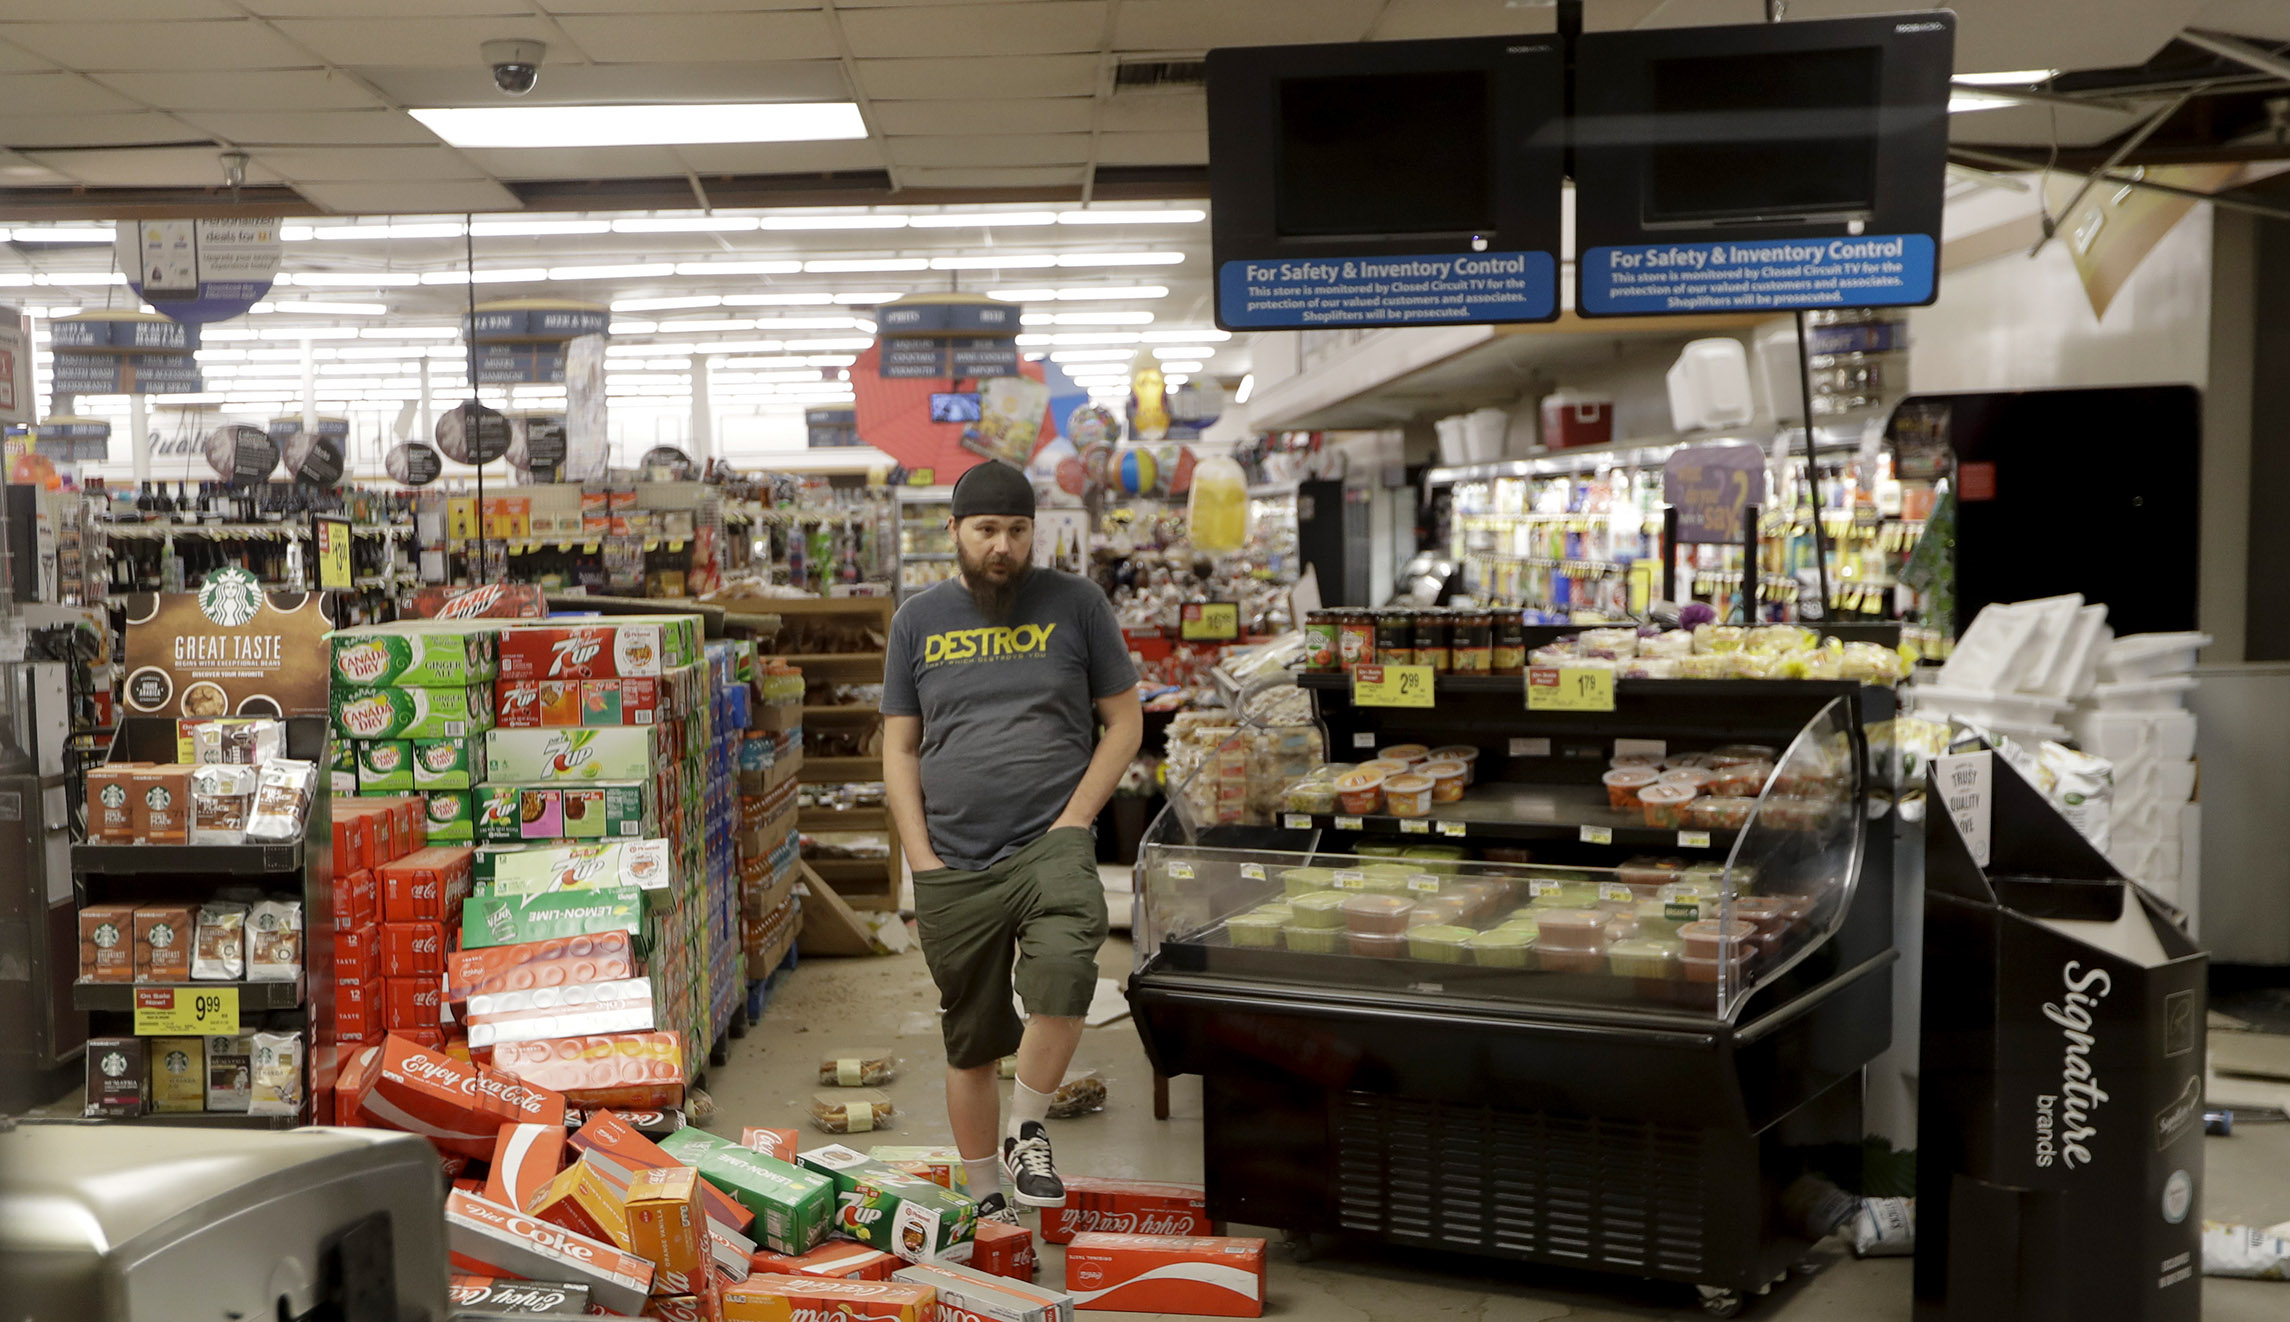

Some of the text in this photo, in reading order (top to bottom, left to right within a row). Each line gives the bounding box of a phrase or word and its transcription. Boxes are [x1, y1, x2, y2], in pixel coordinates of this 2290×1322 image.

[1610, 250, 1642, 268] For
[1645, 247, 1708, 270] Safety
[1730, 244, 1826, 265] Inventory
[1828, 237, 1903, 260] Control
[1246, 264, 1277, 281] For
[1280, 262, 1339, 284] Safety
[1361, 258, 1451, 280] Inventory
[1453, 254, 1525, 276] Control
[1611, 271, 1635, 283] This
[1637, 272, 1668, 283] store
[1680, 267, 1743, 281] monitored
[1761, 265, 1801, 278] Closed
[1803, 263, 1842, 276] Circuit
[1862, 261, 1880, 273] for
[1882, 260, 1903, 273] the
[1248, 286, 1272, 297] This
[1273, 286, 1301, 297] store
[1314, 282, 1373, 295] monitored
[1391, 280, 1429, 293] Closed
[1431, 278, 1468, 291] Circuit
[1487, 276, 1505, 289] for
[1506, 277, 1526, 288] the
[1610, 285, 1671, 299] protection
[1687, 285, 1708, 294] our
[1710, 281, 1750, 293] valued
[1751, 280, 1812, 292] customers
[1814, 277, 1838, 289] and
[1840, 275, 1904, 288] associates.
[1247, 299, 1306, 312] protection
[1321, 299, 1340, 308] our
[1343, 296, 1380, 307] valued
[1382, 294, 1440, 306] customers
[1442, 293, 1464, 304] and
[1466, 291, 1527, 303] associates.
[1667, 295, 1732, 309] Shoplifters
[1733, 293, 1755, 305] will
[1773, 290, 1844, 305] prosecuted.
[1303, 309, 1364, 323] Shoplifters
[1365, 309, 1385, 321] will
[1404, 305, 1471, 320] prosecuted.
[175, 635, 281, 660] GREAT TASTE
[925, 623, 1056, 663] DESTROY
[339, 648, 390, 669] CANADA
[425, 660, 462, 671] GINGER
[978, 654, 1024, 663] DESTROYS
[355, 662, 380, 677] DRY
[434, 669, 454, 678] ALE
[432, 694, 463, 703] GINGER
[440, 701, 456, 709] ALE
[342, 703, 395, 722] CANADA
[358, 716, 384, 732] DRY
[371, 751, 401, 763] CANADA
[380, 759, 395, 767] DRY
[426, 751, 457, 763] CANADA
[437, 759, 451, 767] DRY
[541, 741, 593, 779] 7UP
[1952, 768, 1978, 787] TRUST
[430, 801, 461, 813] CANADA
[1950, 793, 1980, 812] QUALITY
[480, 799, 517, 826] 7UP
[1960, 817, 1975, 834] OVE
[528, 905, 613, 922] LEMON-LIME
[348, 935, 358, 945] 12
[350, 990, 361, 999] 12
[402, 1055, 460, 1088] Enjoy
[2042, 960, 2112, 1170] Signature
[2036, 1094, 2058, 1168] brands
[719, 1153, 794, 1186] LEMON-LIME
[835, 1190, 883, 1226] 7UP
[465, 1202, 594, 1262] Diet Coke
[1058, 1208, 1195, 1237] Enjoy Coca-Cola
[656, 1208, 671, 1268] ORANGE VANILLA
[490, 1285, 567, 1313] Enjoy
